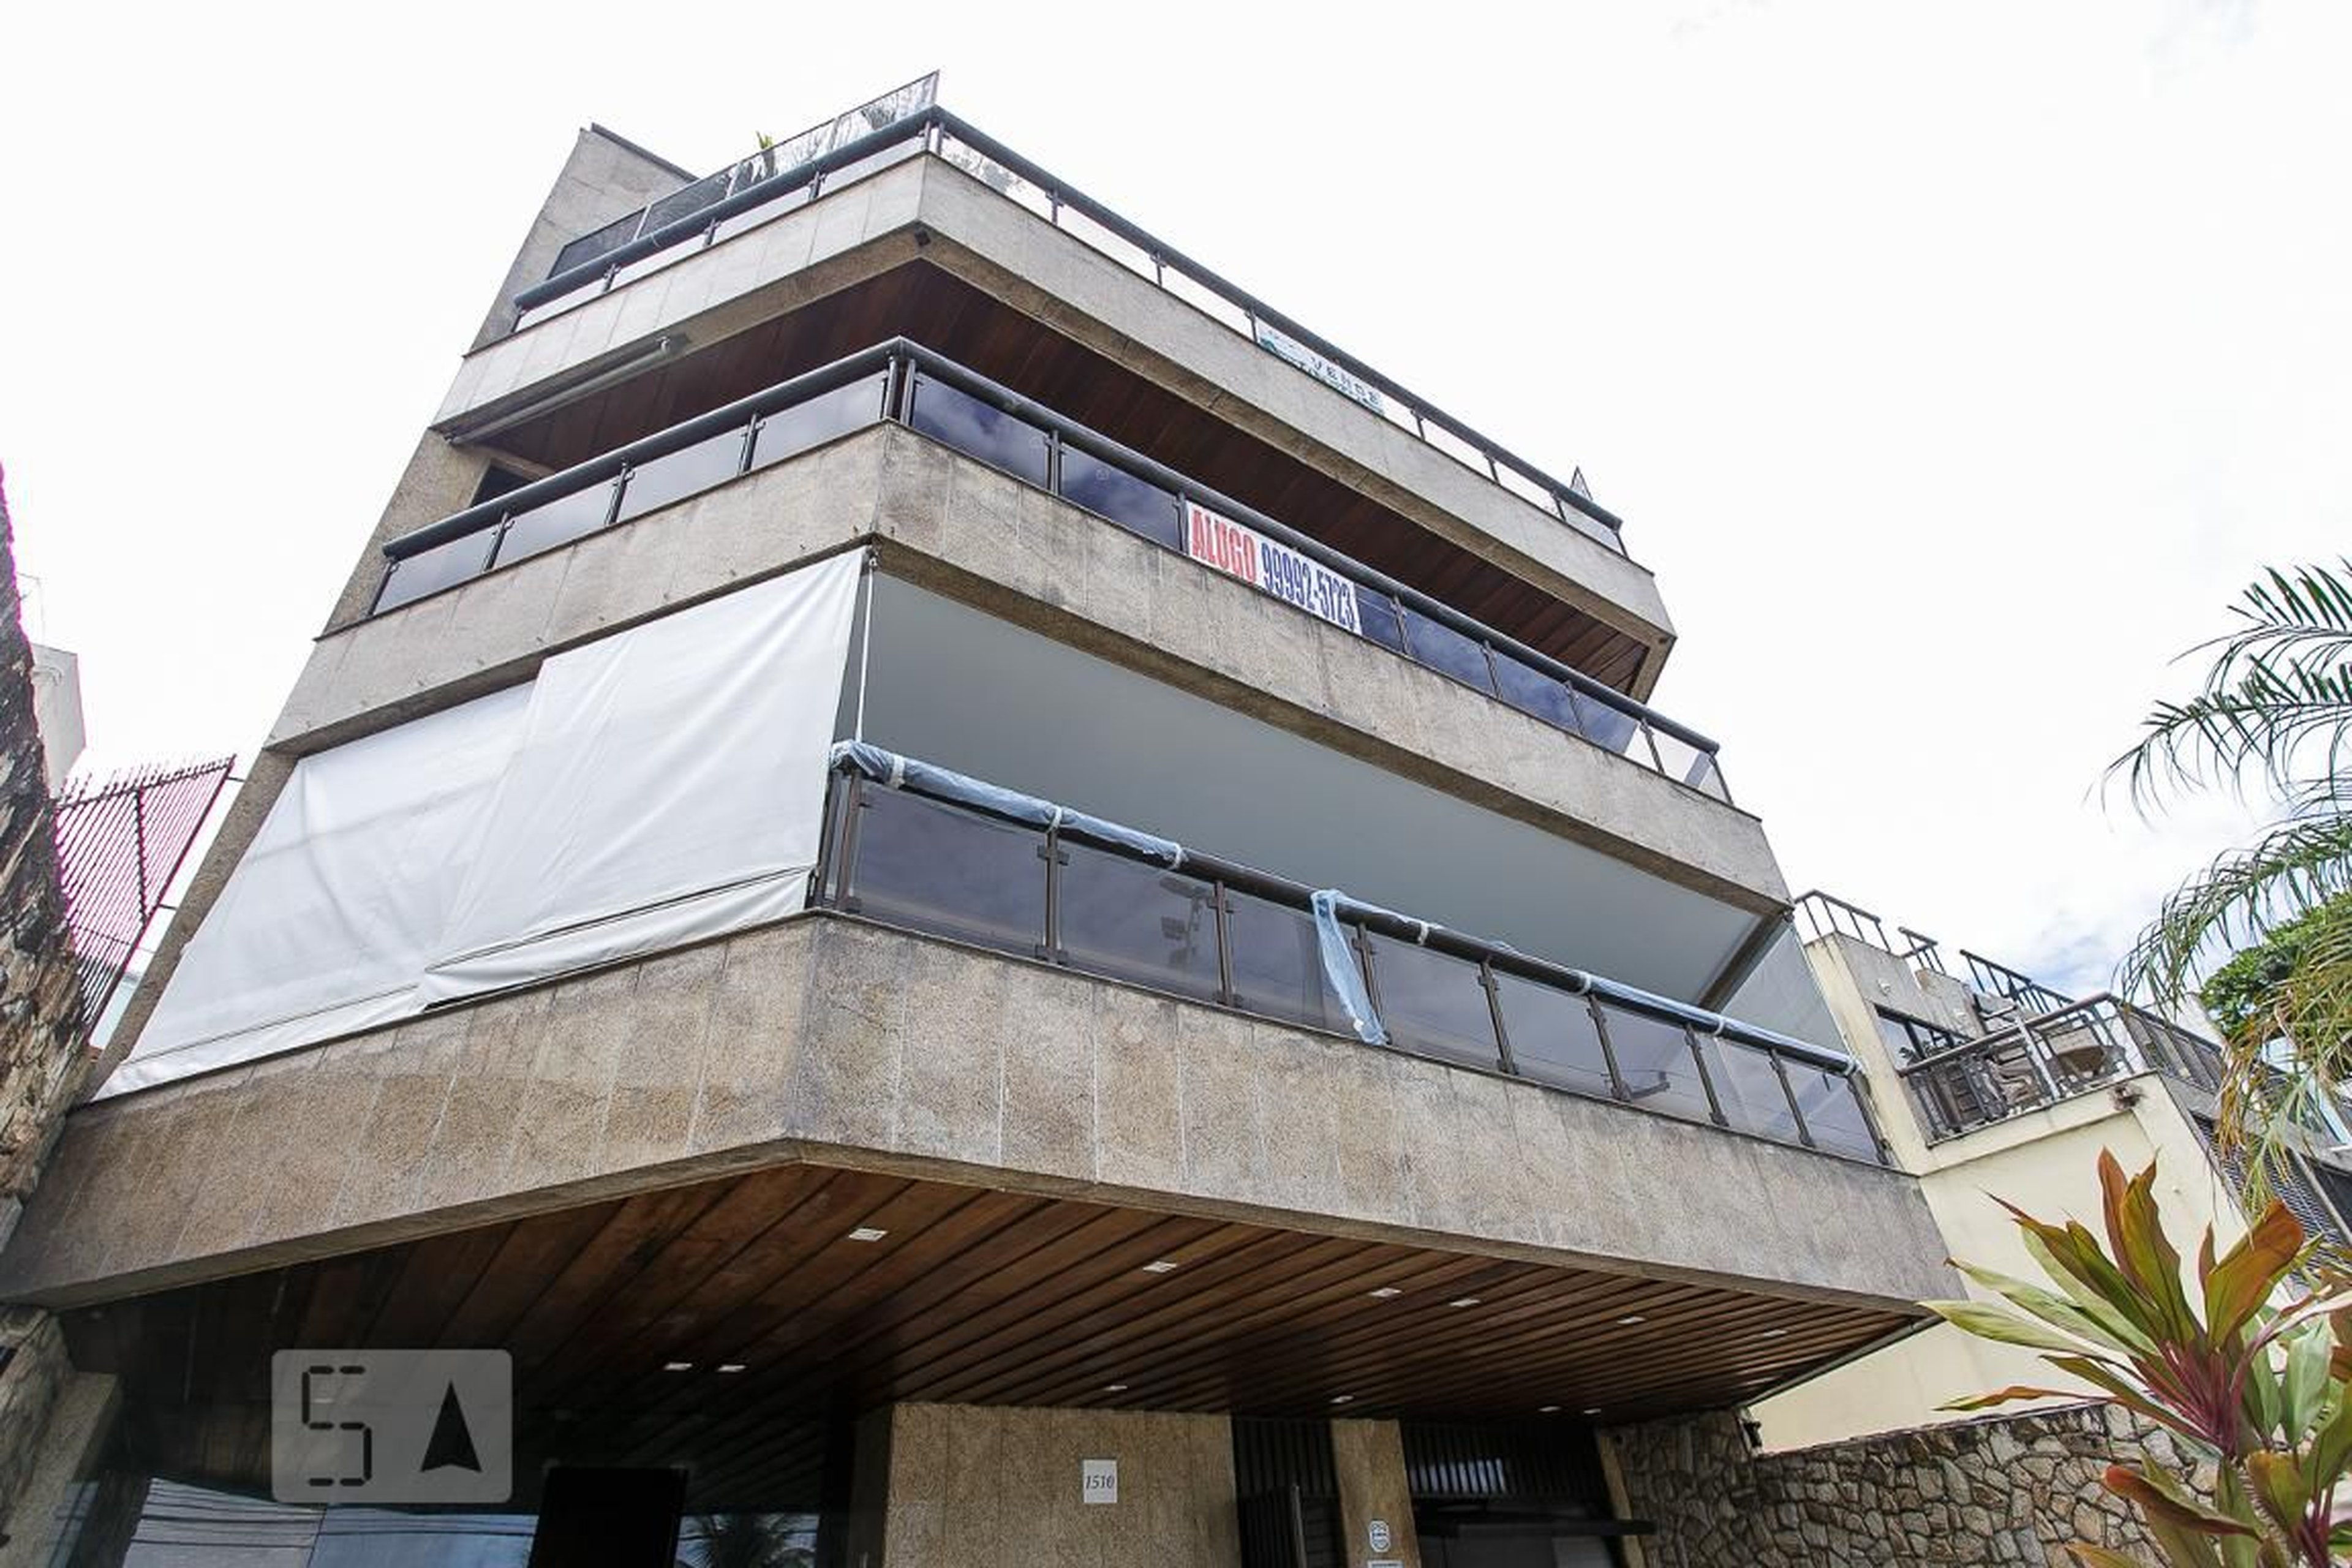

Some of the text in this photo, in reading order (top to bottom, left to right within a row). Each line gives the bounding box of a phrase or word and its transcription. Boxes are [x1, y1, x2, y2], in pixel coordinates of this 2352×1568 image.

[1192, 510, 1355, 631] ALUGO 99992-5723
[1086, 1475, 1115, 1490] 1510
